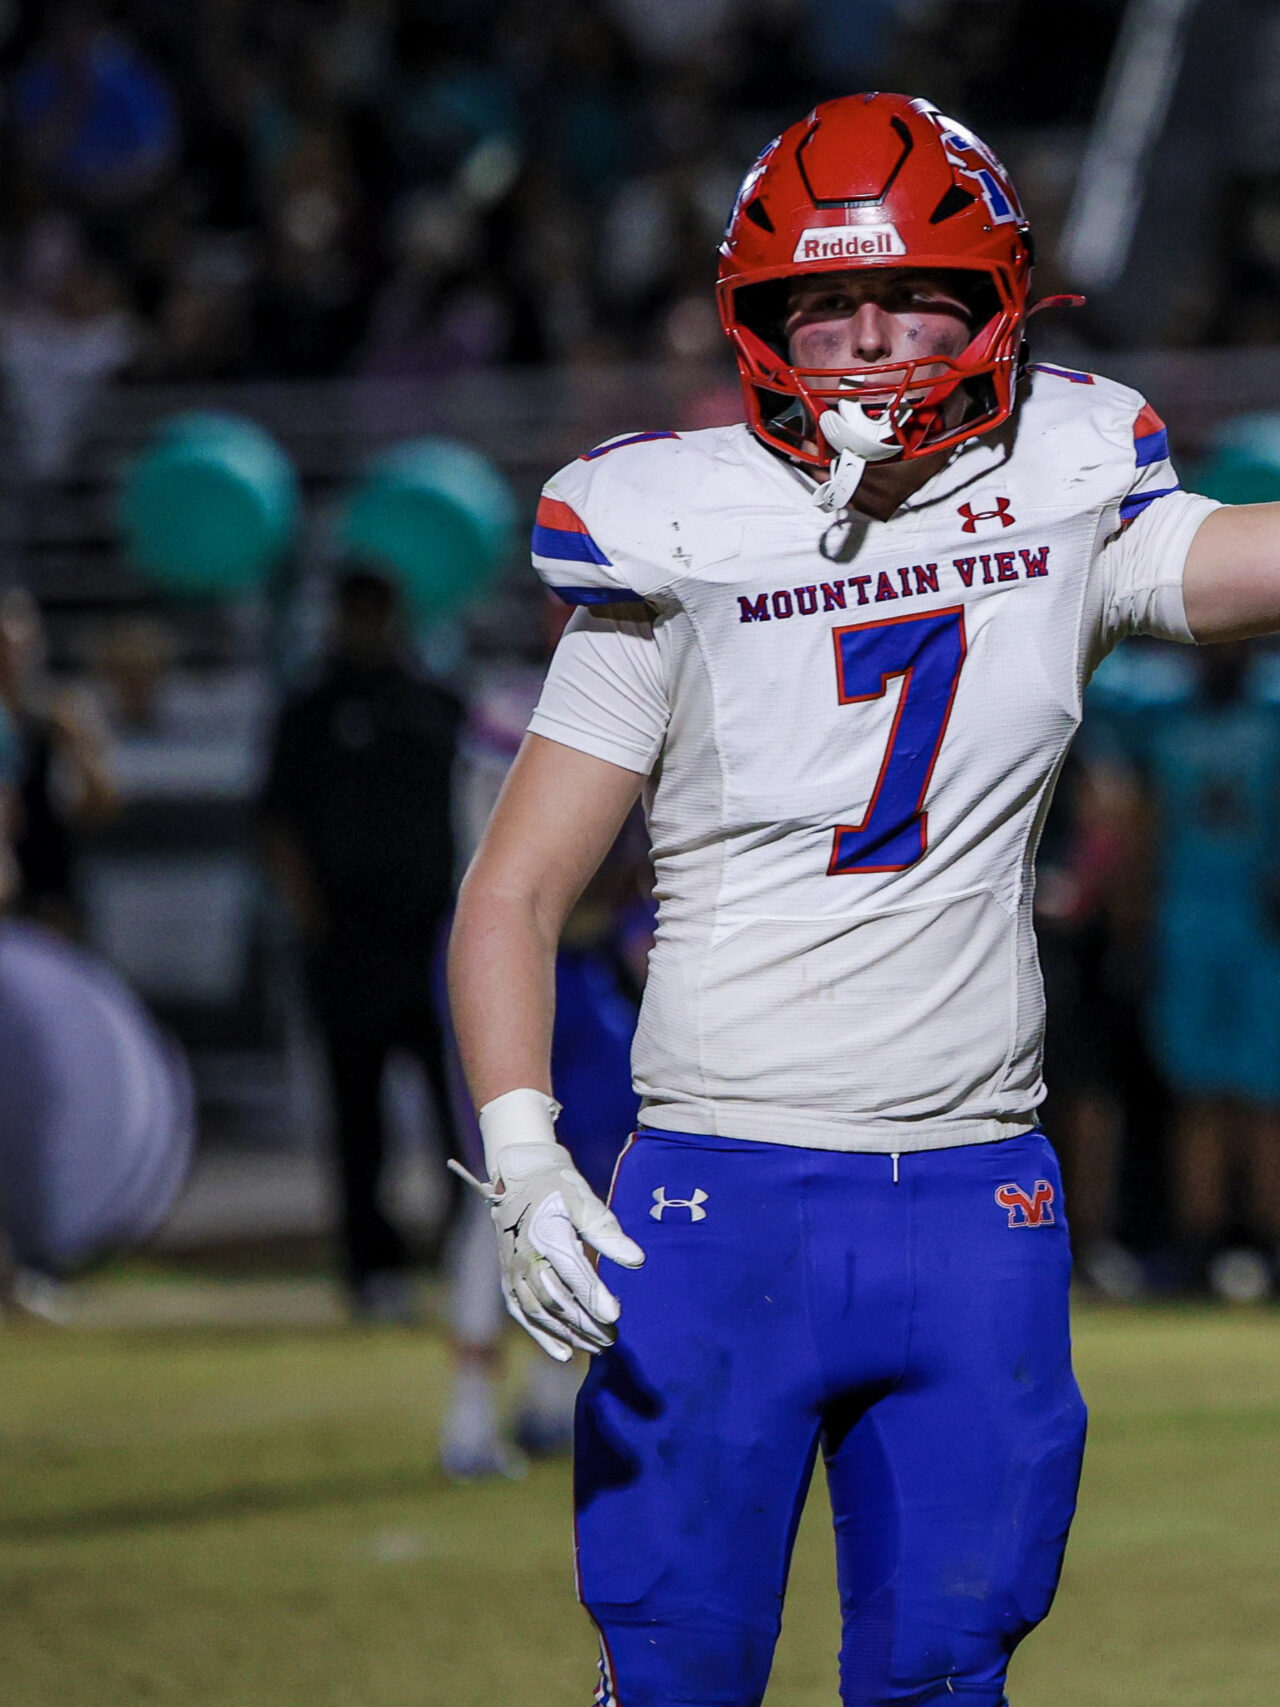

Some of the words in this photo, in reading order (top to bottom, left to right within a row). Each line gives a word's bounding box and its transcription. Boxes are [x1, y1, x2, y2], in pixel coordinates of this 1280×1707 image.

[804, 233, 892, 258] Riddell
[737, 563, 940, 623] MOUNTAIN
[953, 546, 1050, 588] VIEW
[826, 603, 968, 877] 7
